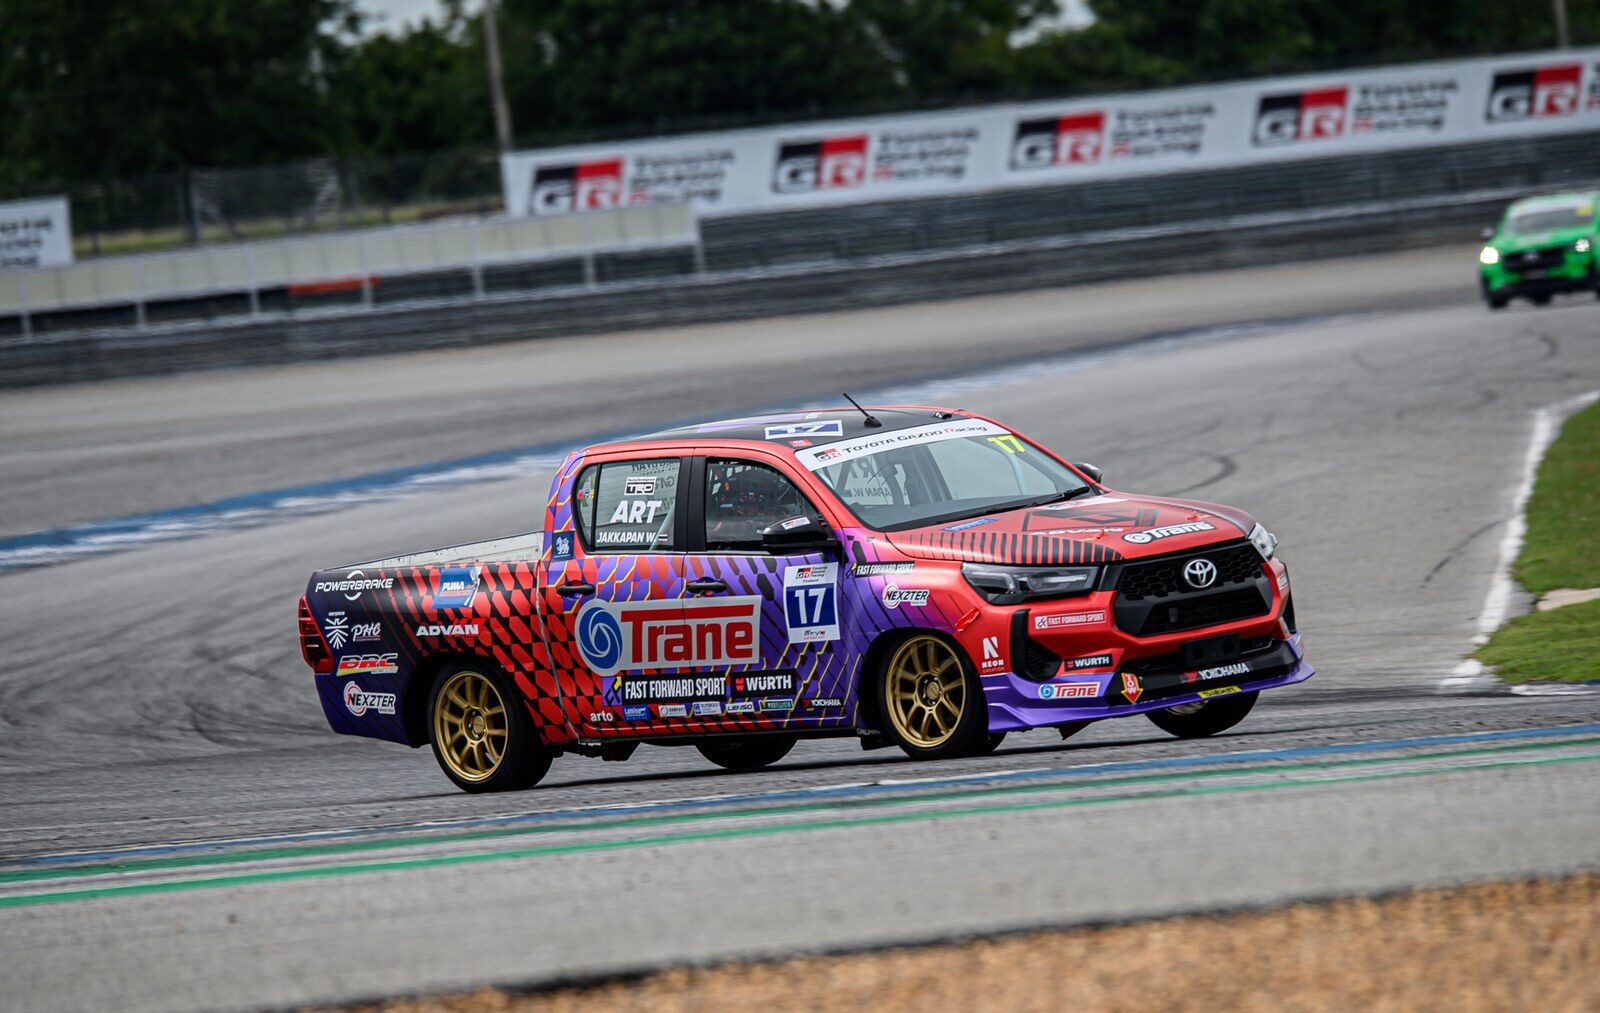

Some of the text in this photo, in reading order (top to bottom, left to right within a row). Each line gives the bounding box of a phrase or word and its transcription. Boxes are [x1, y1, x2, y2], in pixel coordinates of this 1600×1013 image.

[842, 438, 895, 454] TOYOTA
[898, 429, 943, 441] GAZOO
[944, 424, 988, 433] Racing
[986, 435, 1026, 455] 17
[609, 500, 663, 524] ART
[597, 531, 657, 544] JAKKAPAN W.
[1143, 521, 1216, 539] Trane
[856, 562, 915, 576] FAST FORWARD SPORT
[315, 578, 394, 593] POWERBRAKE
[884, 590, 928, 601] NEXZTER
[794, 587, 827, 625] 17
[1049, 613, 1104, 625] FAST FORWARD SPORT
[416, 624, 479, 636] ADVAN
[621, 604, 755, 663] Trane
[981, 659, 1004, 669] NEON
[1199, 663, 1250, 681] YOKOHAMA
[625, 677, 726, 699] FAST FORWARD SPORT
[1054, 683, 1098, 697] Trane
[1124, 674, 1137, 695] TOW
[347, 693, 395, 707] NEXZTER
[590, 711, 613, 722] arto
